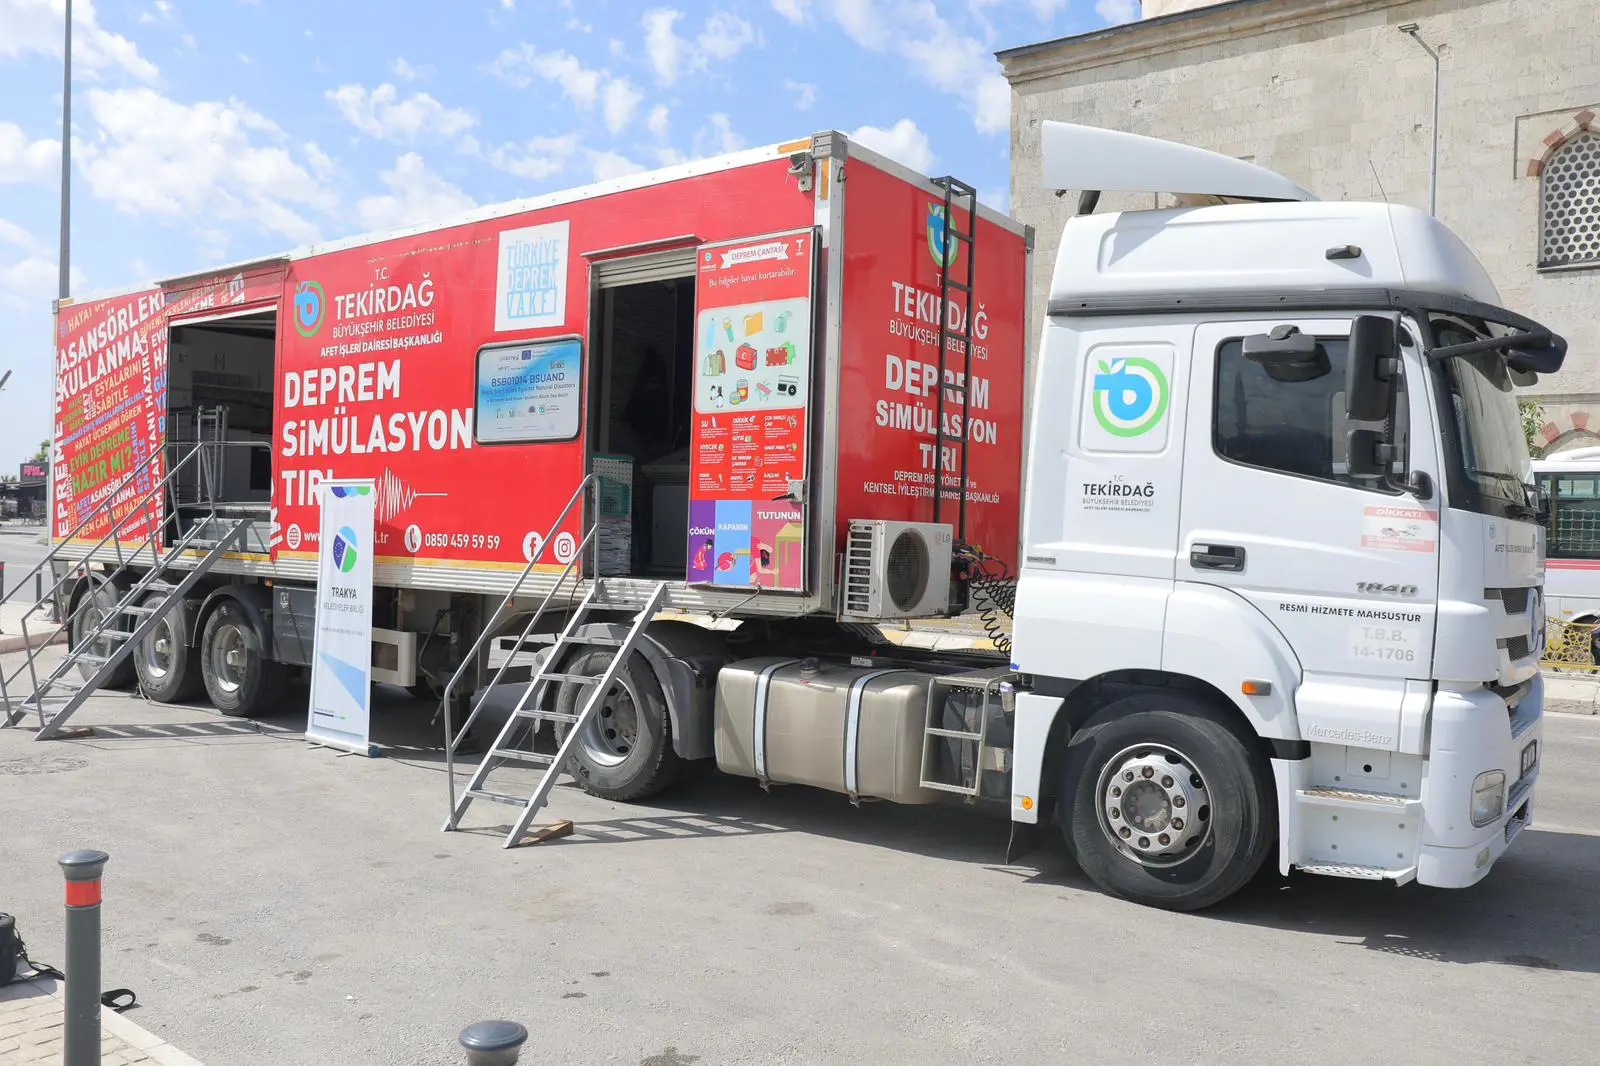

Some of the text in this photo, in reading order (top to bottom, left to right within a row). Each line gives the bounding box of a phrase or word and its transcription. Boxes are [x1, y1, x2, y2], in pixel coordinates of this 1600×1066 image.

[732, 249, 757, 260] DEPREM
[375, 267, 390, 281] T.C.
[708, 278, 718, 288] Bu
[718, 275, 740, 288] bilgiler
[740, 274, 757, 285] hayat
[335, 271, 435, 320] TEKİRDAĞ
[332, 309, 435, 339] BÜYÜKŞEHİR BELEDİYESİ
[320, 331, 443, 358] AFET İŞLERİ DAİRESİ BAŞKANLIĞI
[889, 318, 989, 361] BÜYÜKŞEHİ BELEİYESİ
[60, 331, 142, 399] KULLANMA
[284, 359, 401, 408] DEPREM
[529, 372, 565, 384] BSUAND
[885, 354, 990, 410] DEPREM
[90, 426, 131, 462] DEPREME
[71, 459, 109, 497] HAZIR
[894, 470, 923, 483] DEPREM
[923, 472, 936, 485] RİS
[864, 481, 897, 495] KENTSEL
[897, 483, 936, 499] İYİLEŞTİRM
[965, 491, 1000, 504] BAŞKANLIĞI
[1082, 480, 1155, 498] TEKİRDAĞ
[757, 511, 801, 520] TUTUNUN
[689, 526, 716, 536] ÇÖKÜN
[718, 523, 749, 532] KAPANIN
[425, 533, 501, 550] 0850 459 59 59
[331, 586, 358, 600] TRAKYA
[1356, 581, 1419, 597] 1840
[1279, 602, 1422, 623] RESMİ HİZMETE MAHSUSTUR
[1361, 626, 1408, 644] T.B.B.
[1351, 644, 1416, 663] 14-1706
[1305, 722, 1393, 746] Mercedes-Benz
